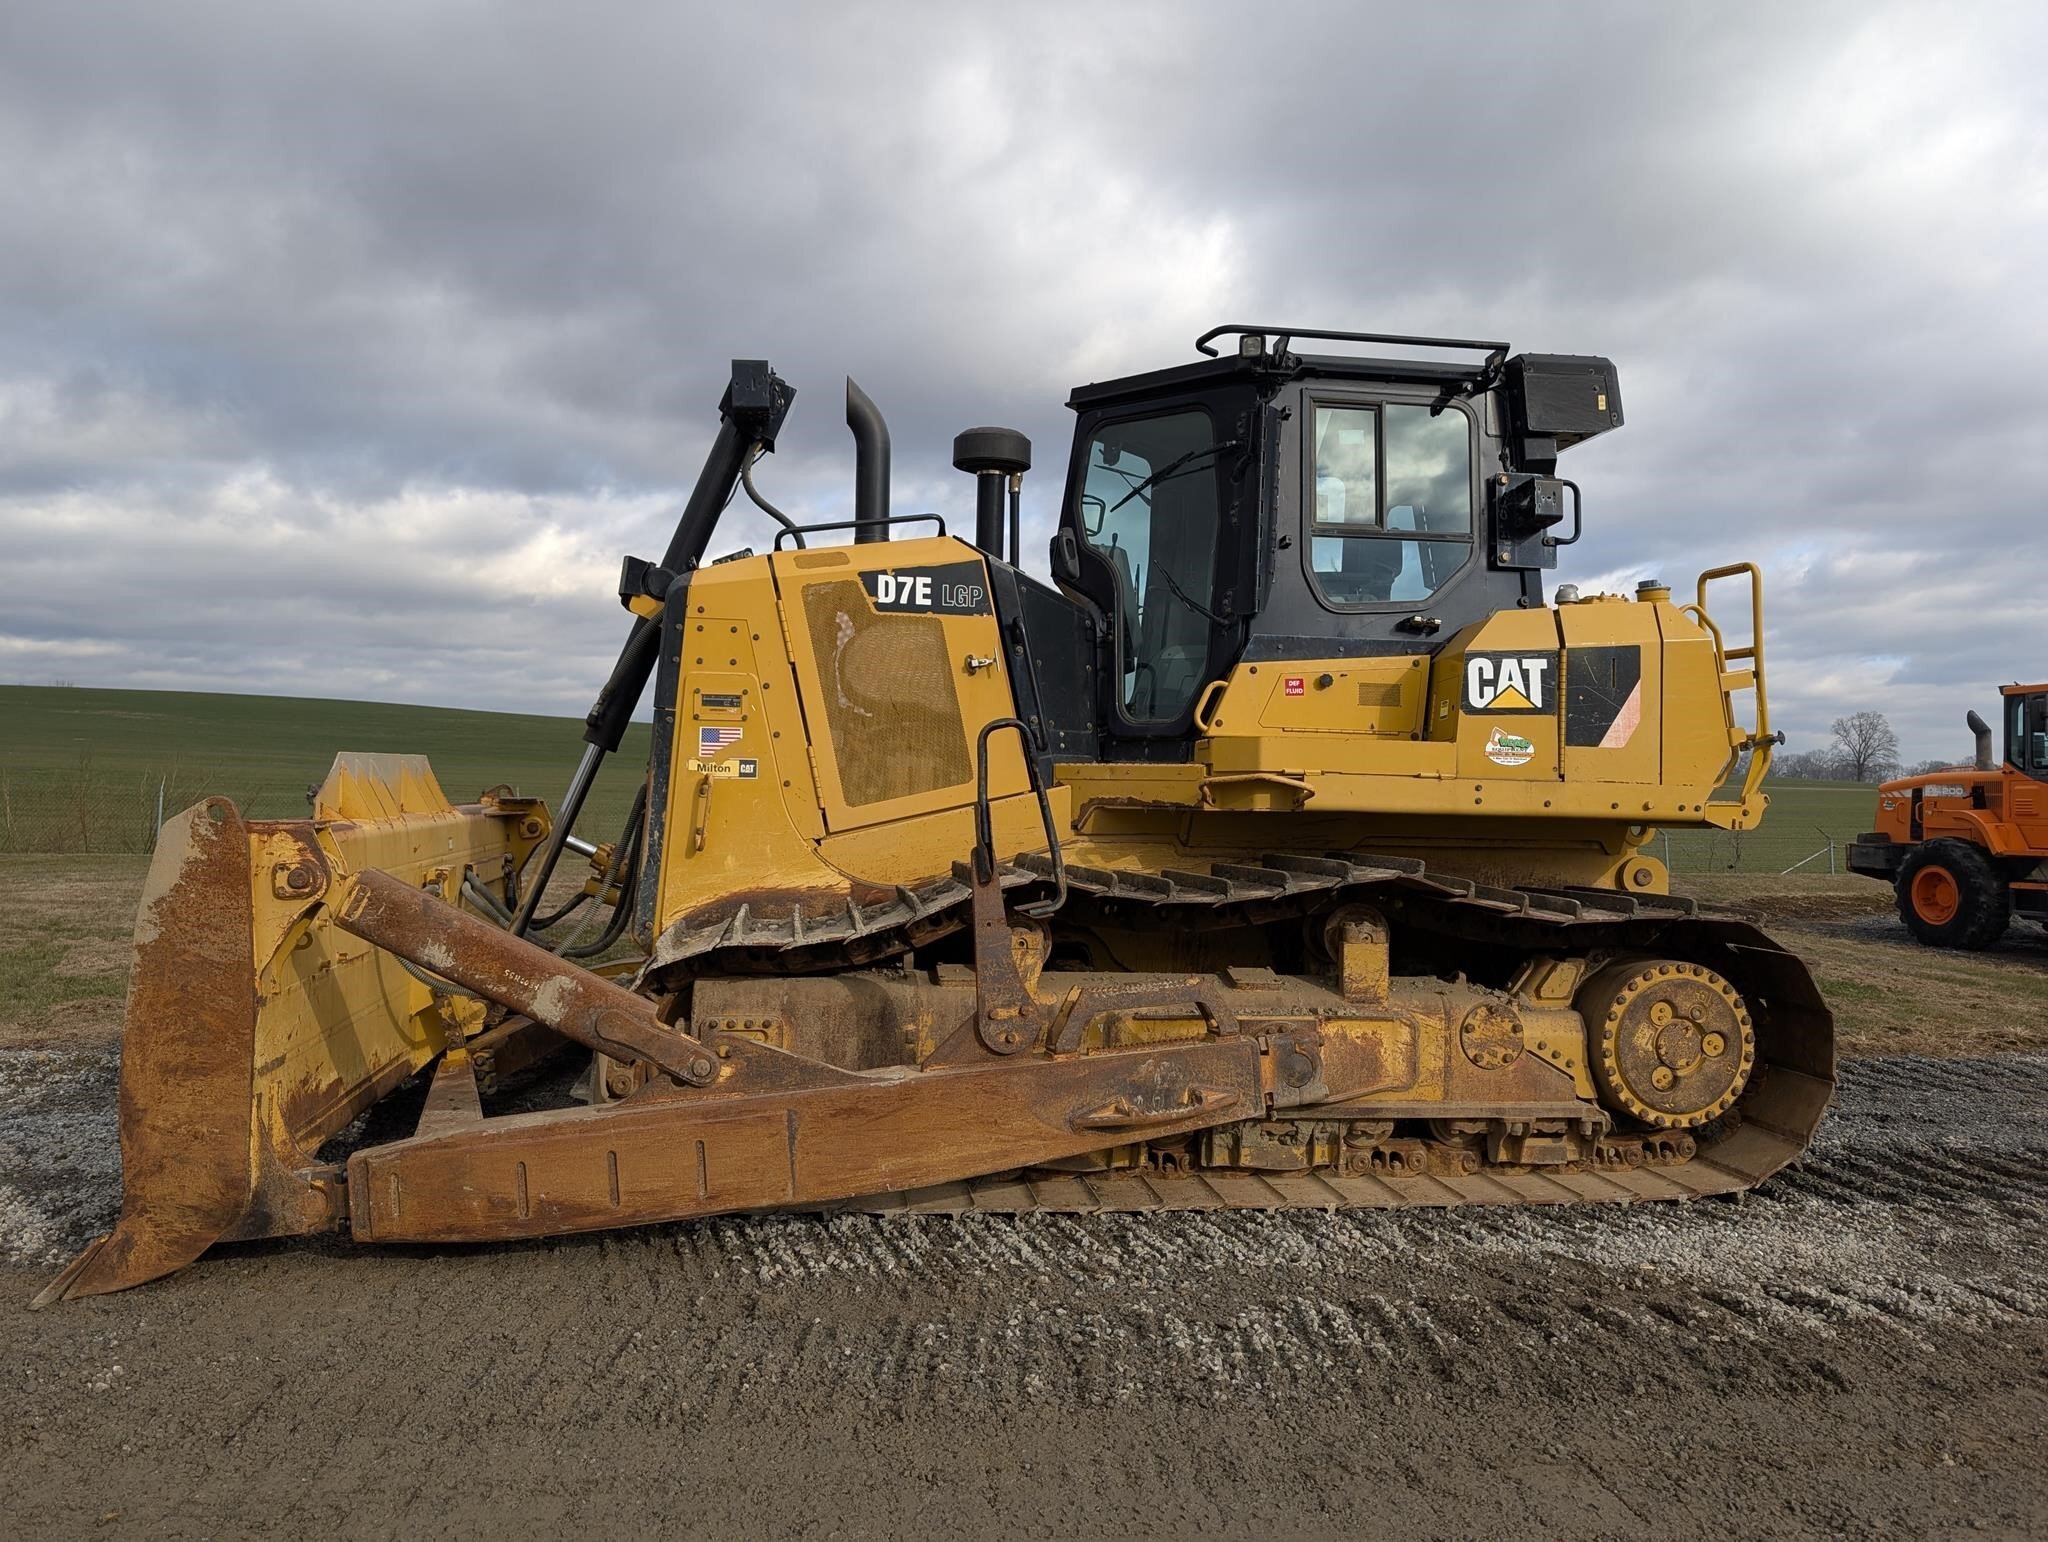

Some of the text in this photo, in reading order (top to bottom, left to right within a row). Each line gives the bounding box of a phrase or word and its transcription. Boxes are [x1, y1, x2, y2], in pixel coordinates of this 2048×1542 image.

[877, 574, 983, 607] D7E LGP
[1468, 657, 1548, 708] CAT
[697, 763, 731, 773] Milton
[740, 764, 756, 774] CAT
